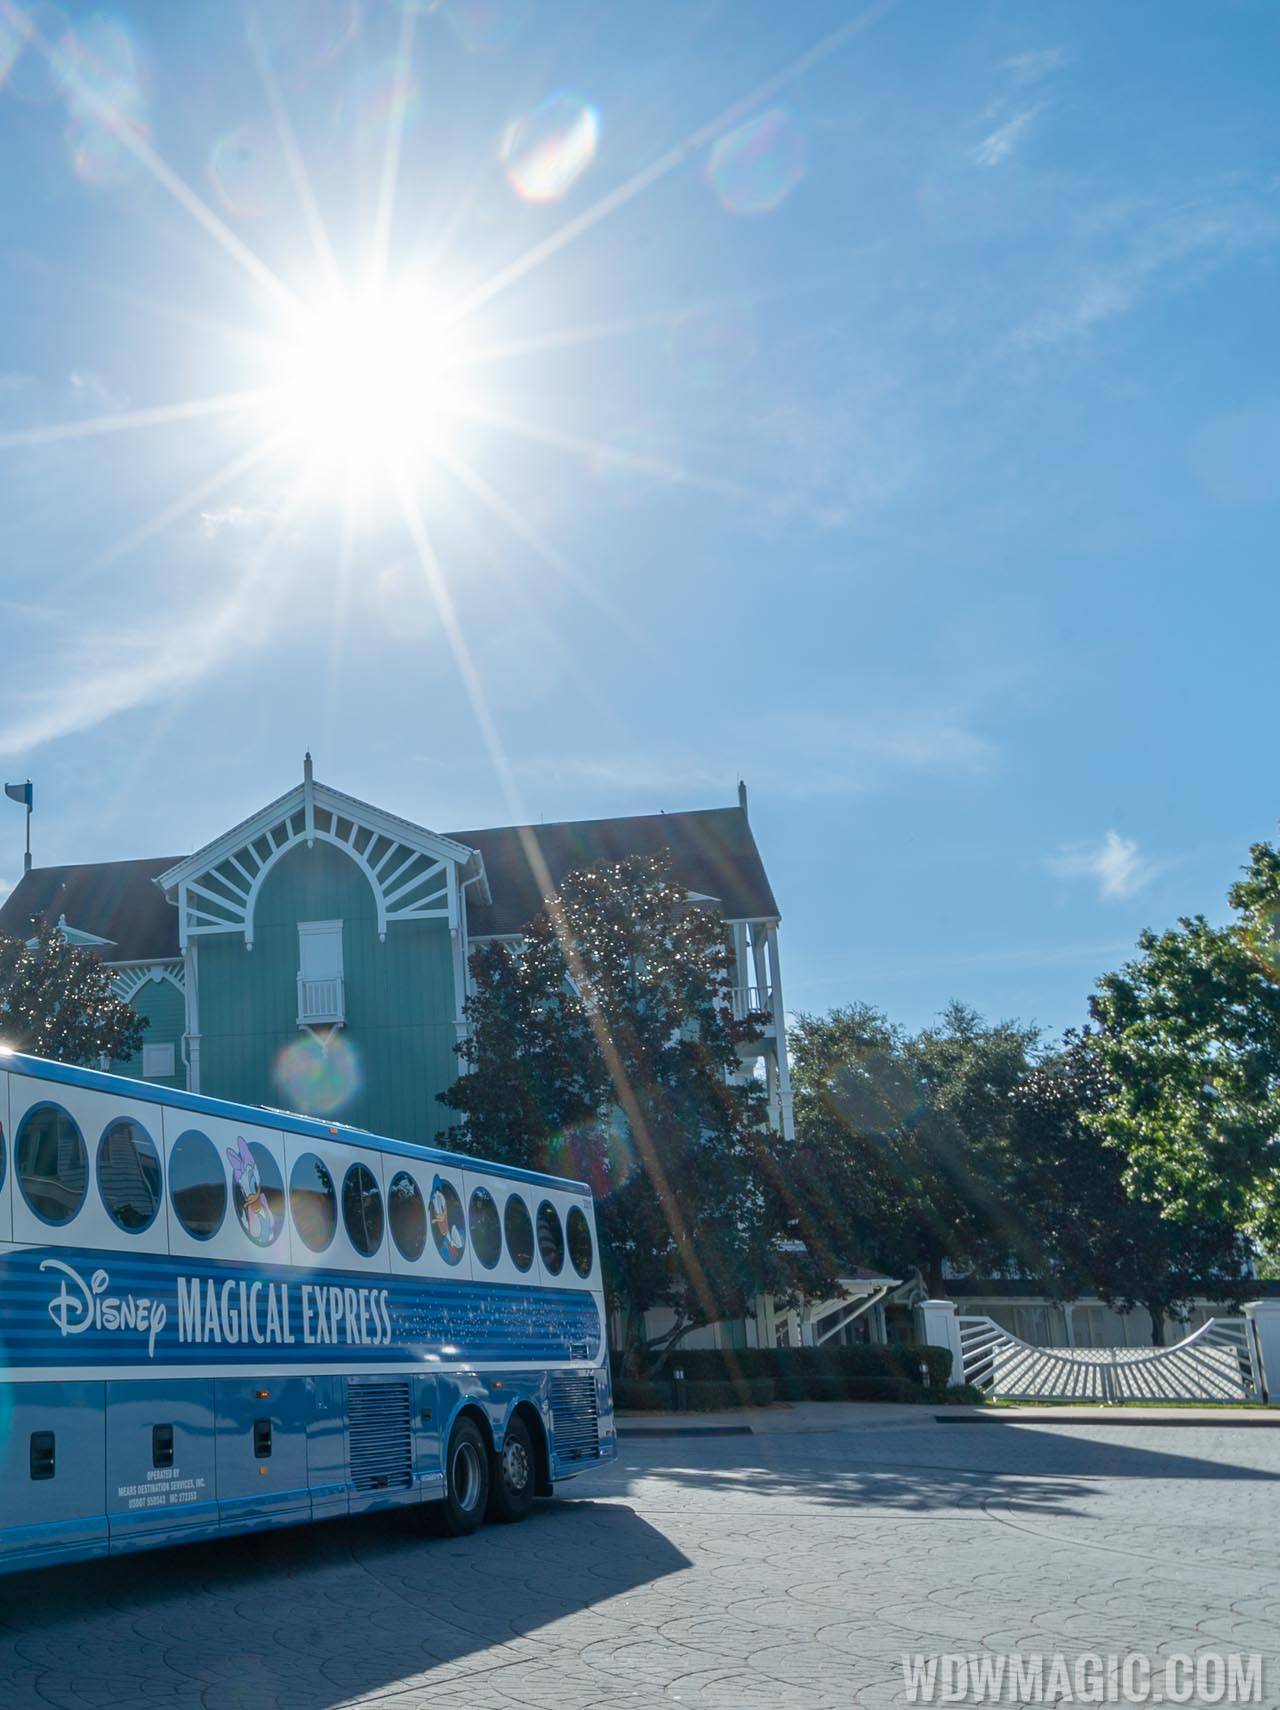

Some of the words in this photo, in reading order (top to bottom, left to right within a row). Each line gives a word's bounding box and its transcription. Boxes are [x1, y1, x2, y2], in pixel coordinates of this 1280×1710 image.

[177, 1277, 295, 1343] MAGICAL
[302, 1284, 392, 1345] EXPRESS
[147, 1470, 172, 1480] OPERATED
[173, 1468, 180, 1478] BY
[118, 1486, 137, 1496] MEARS
[137, 1482, 169, 1494] DESTINATION
